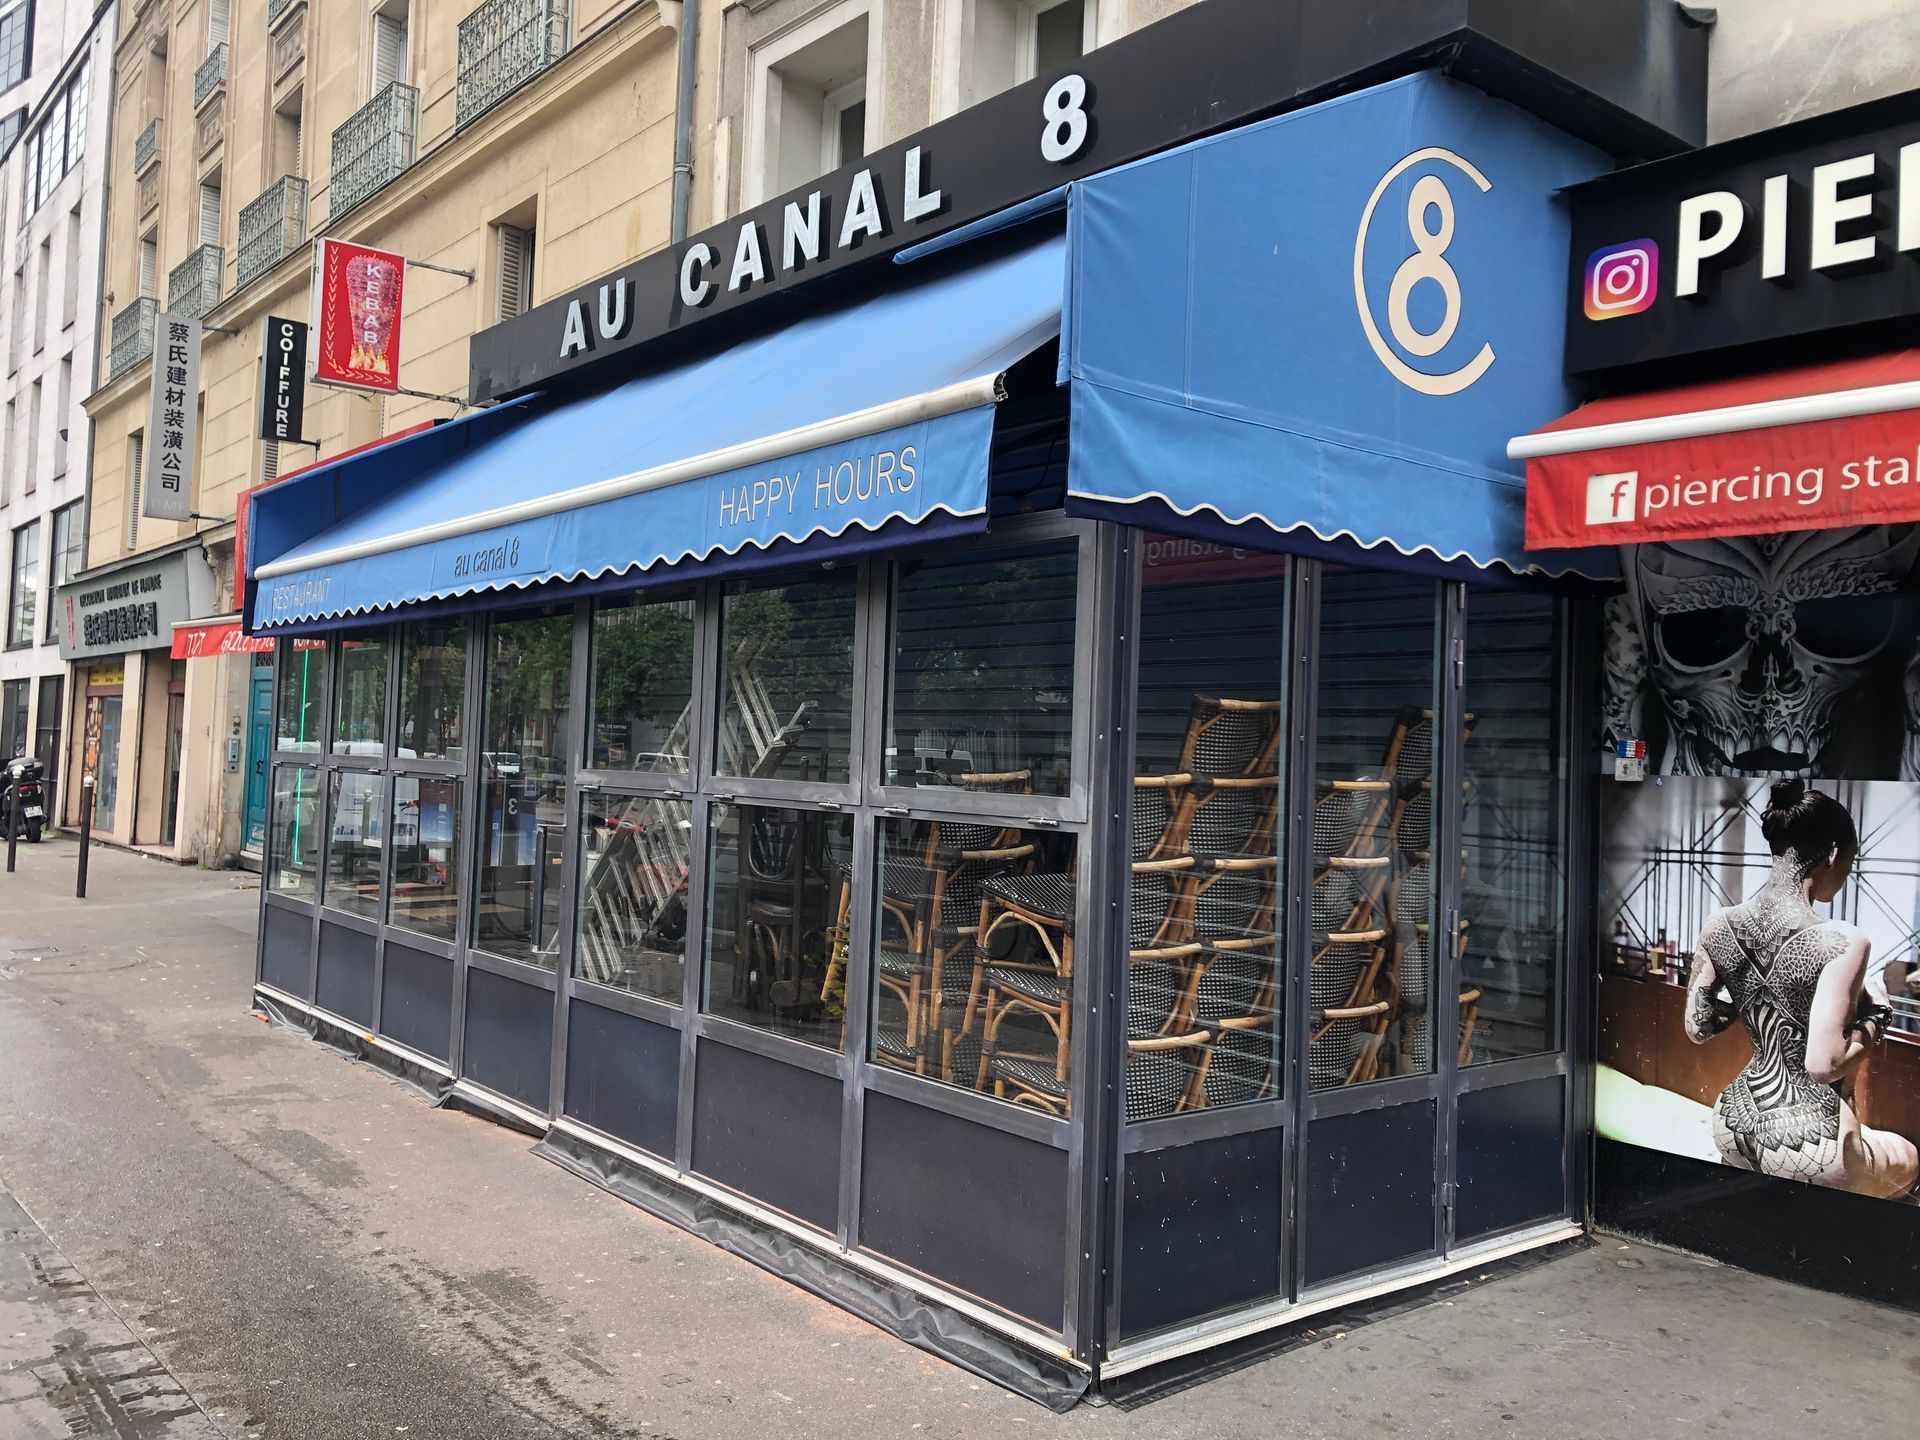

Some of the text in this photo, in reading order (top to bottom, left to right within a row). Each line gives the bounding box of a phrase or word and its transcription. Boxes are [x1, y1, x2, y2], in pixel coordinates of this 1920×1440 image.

[559, 73, 1089, 358] AU CANAL 8
[363, 263, 381, 344] KEBAB
[161, 321, 190, 494] 蔡氏建材装潢公司
[275, 323, 294, 438] COIFFURE
[718, 445, 918, 529] HAPPY HOURS
[1643, 465, 1825, 511] piercing
[272, 576, 332, 609] RESTAURANT
[454, 538, 520, 576] au canal 8
